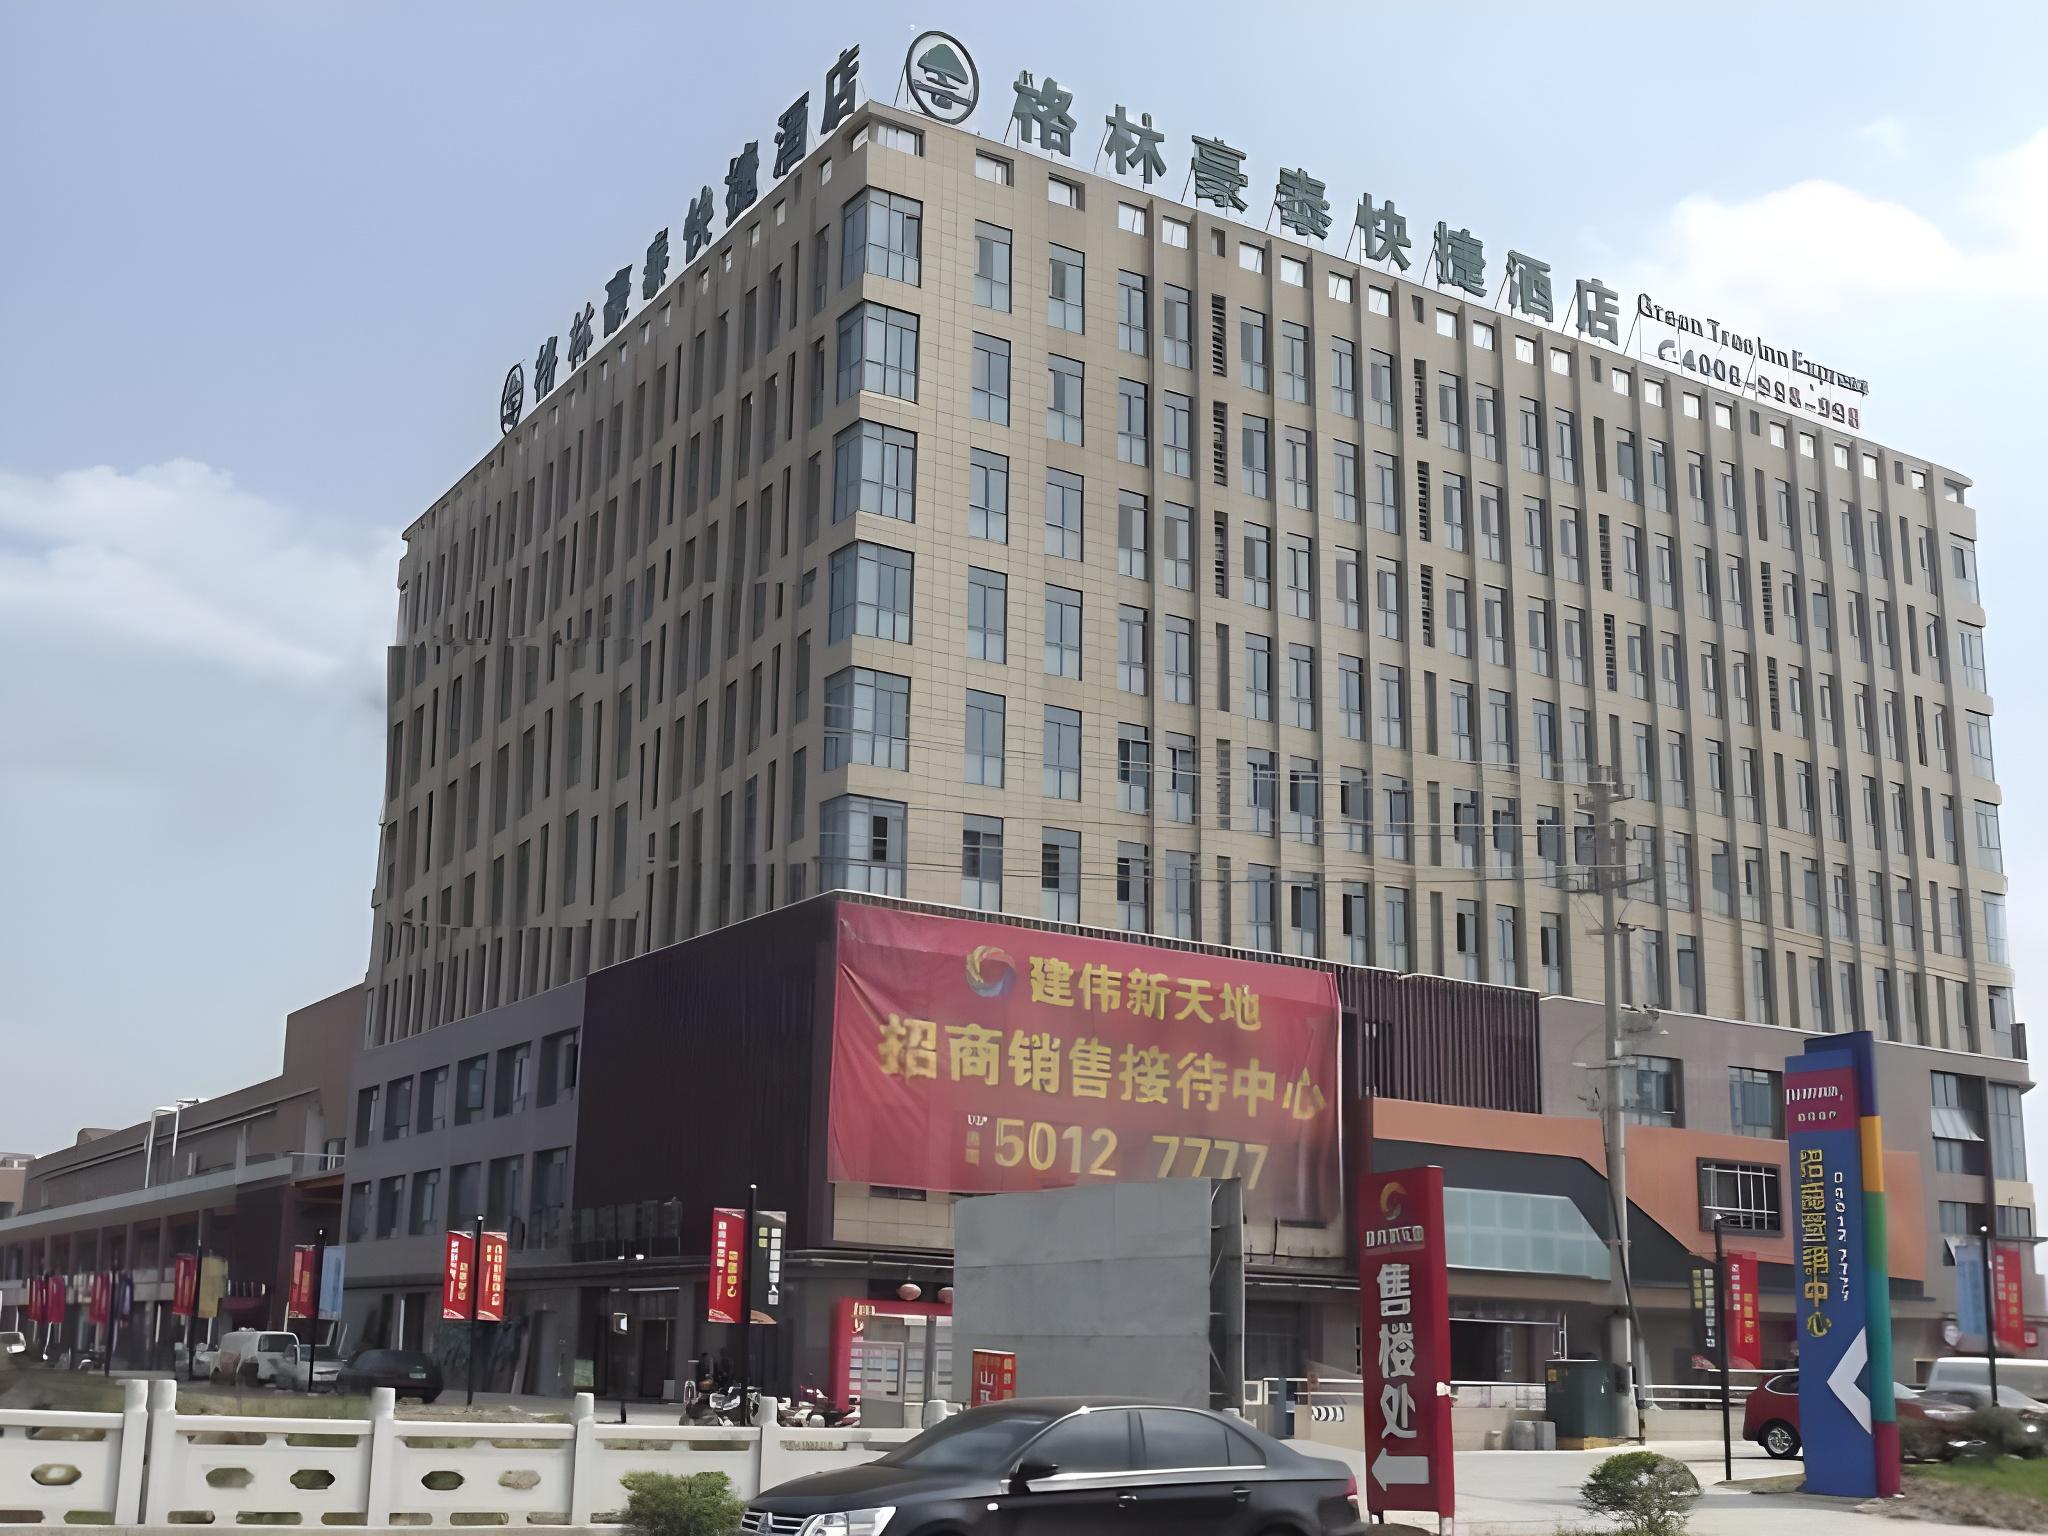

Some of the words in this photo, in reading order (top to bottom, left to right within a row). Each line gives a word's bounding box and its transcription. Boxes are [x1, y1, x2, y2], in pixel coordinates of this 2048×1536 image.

[1013, 70, 1620, 346] 格林豪泰快捷酒店
[1757, 336, 1789, 369] Inn
[1029, 956, 1262, 1031] 建伟新天地
[878, 1013, 1328, 1121] 招商销售接待中心
[994, 1117, 1119, 1177] 5012
[1151, 1134, 1270, 1191] 7777
